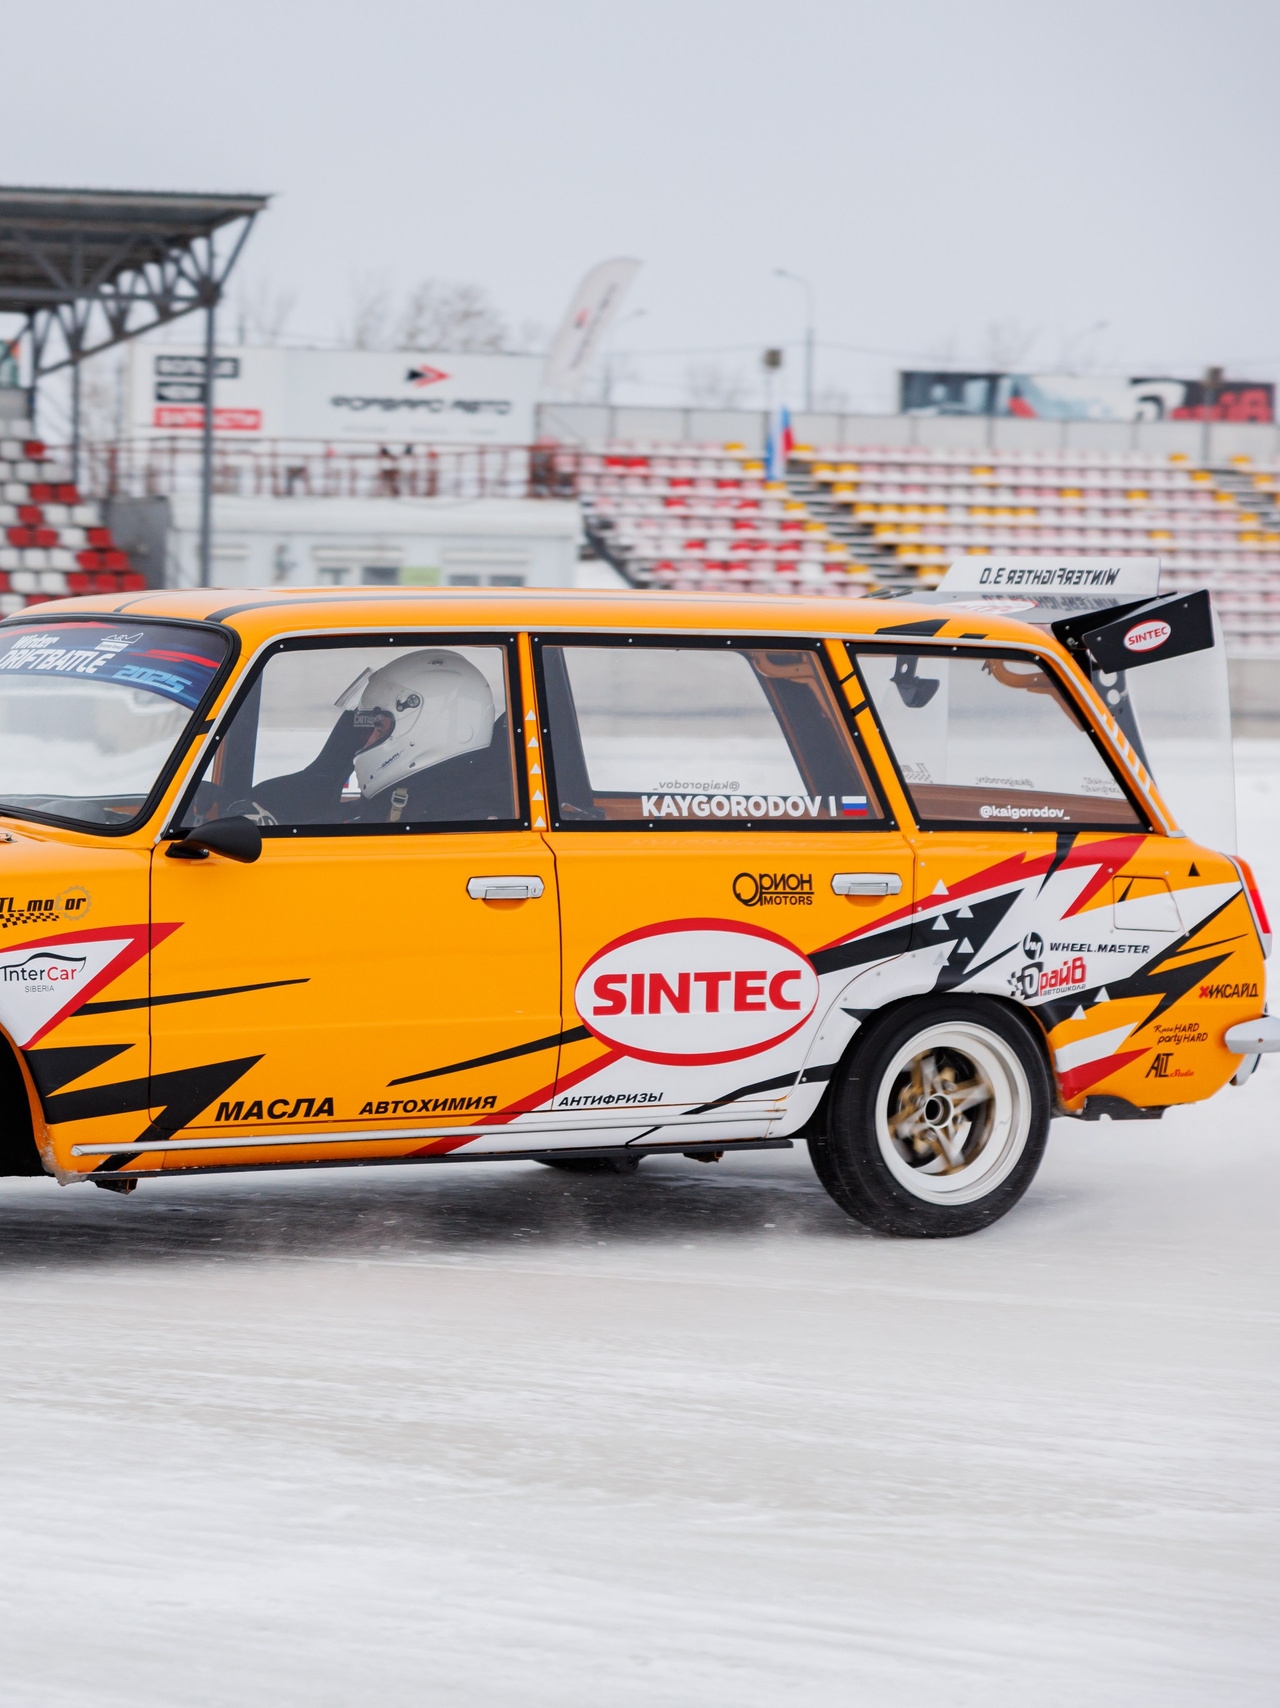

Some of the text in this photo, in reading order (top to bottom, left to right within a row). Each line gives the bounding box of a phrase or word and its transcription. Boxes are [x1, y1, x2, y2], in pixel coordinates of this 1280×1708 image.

[1128, 626, 1169, 646] SINTEC
[111, 664, 193, 694] 2025
[641, 795, 822, 817] KAYGORODOV
[980, 805, 1070, 821] @kaigorodov_
[763, 895, 813, 906] MOTORS
[1050, 942, 1151, 954] WHEEL.MASTER
[3, 964, 77, 982] InterCar
[24, 985, 55, 993] SIBERIA
[592, 970, 802, 1016] SINTEC
[214, 1091, 664, 1122] МАСЛА АВТОХИМИЯ АНТИФРИЗЫ
